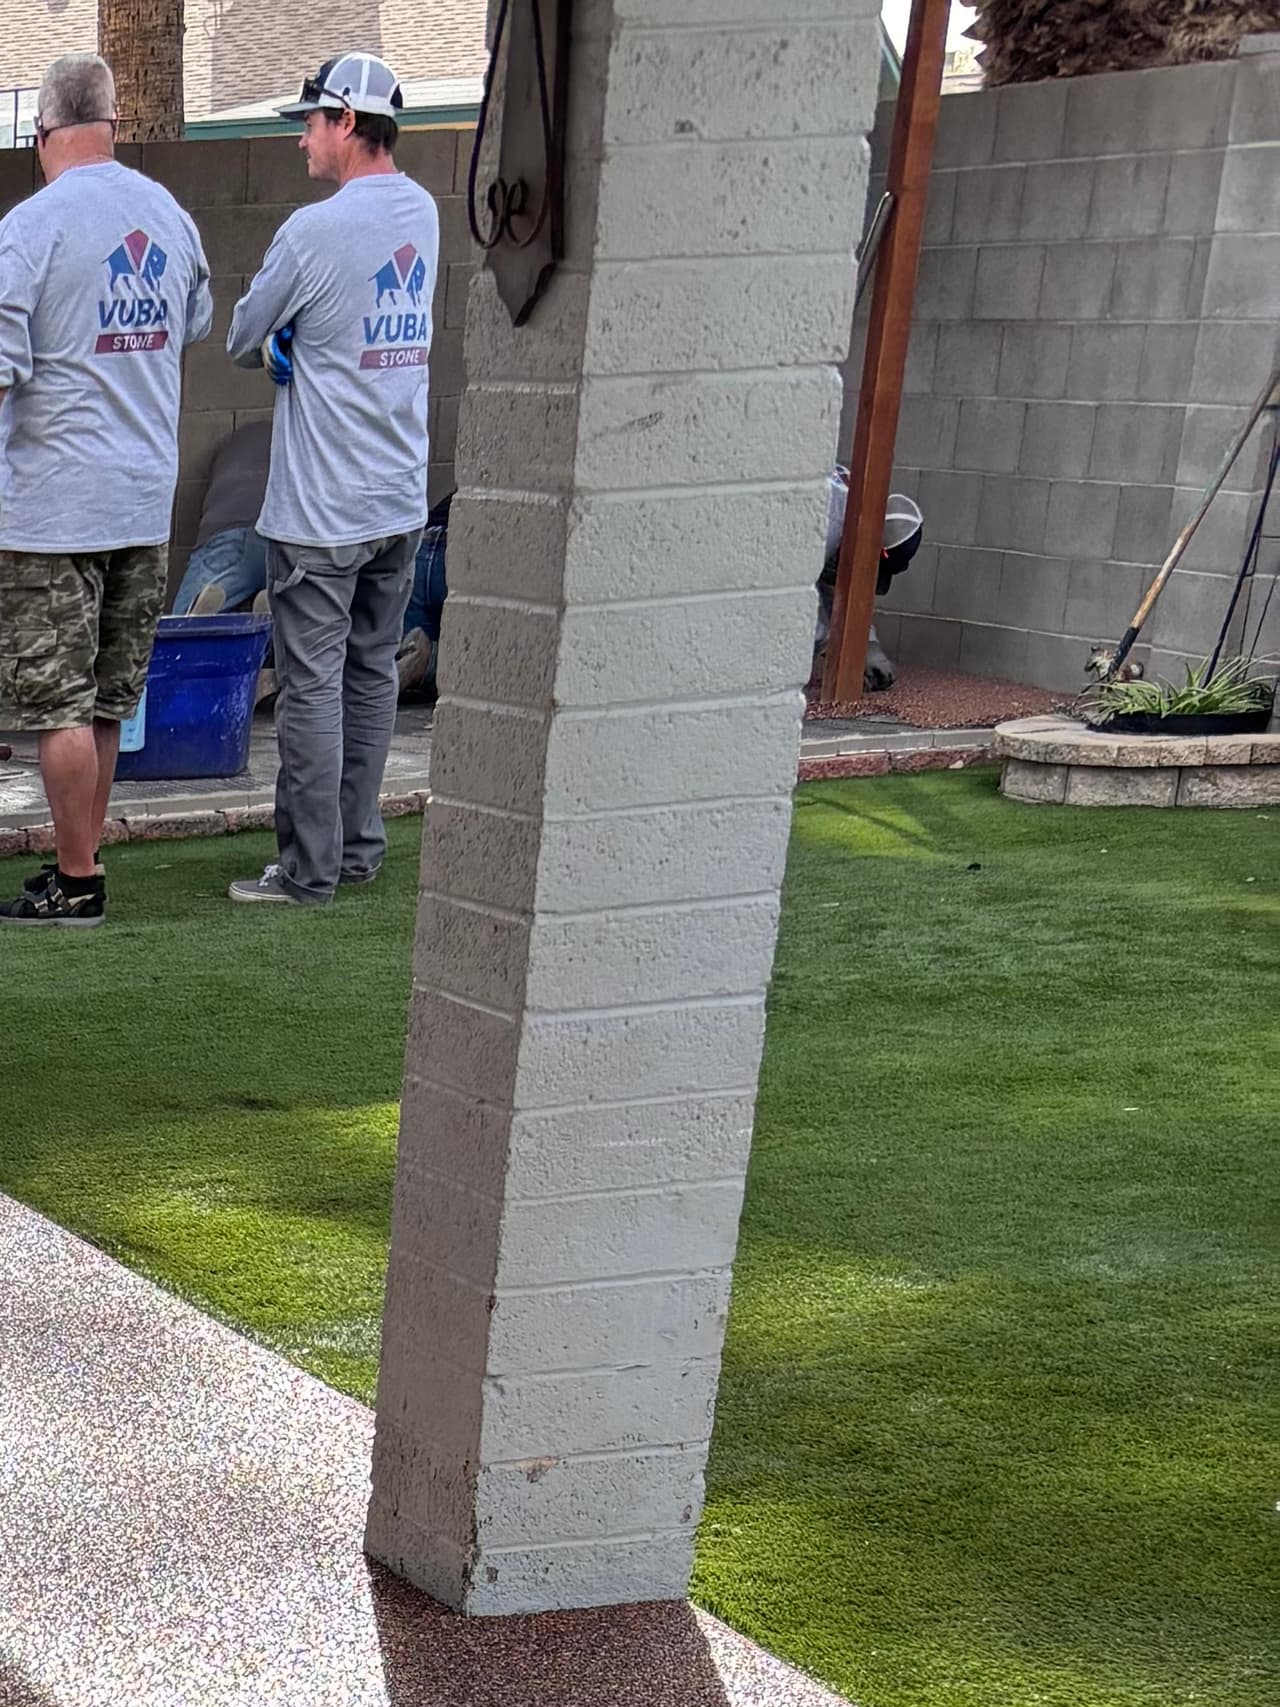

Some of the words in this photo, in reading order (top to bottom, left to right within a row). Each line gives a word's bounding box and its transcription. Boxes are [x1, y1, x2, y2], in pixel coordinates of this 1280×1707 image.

[99, 299, 169, 329] VUBA
[363, 312, 427, 345] VUBA
[112, 334, 155, 350] STONE
[379, 349, 420, 367] STONE
